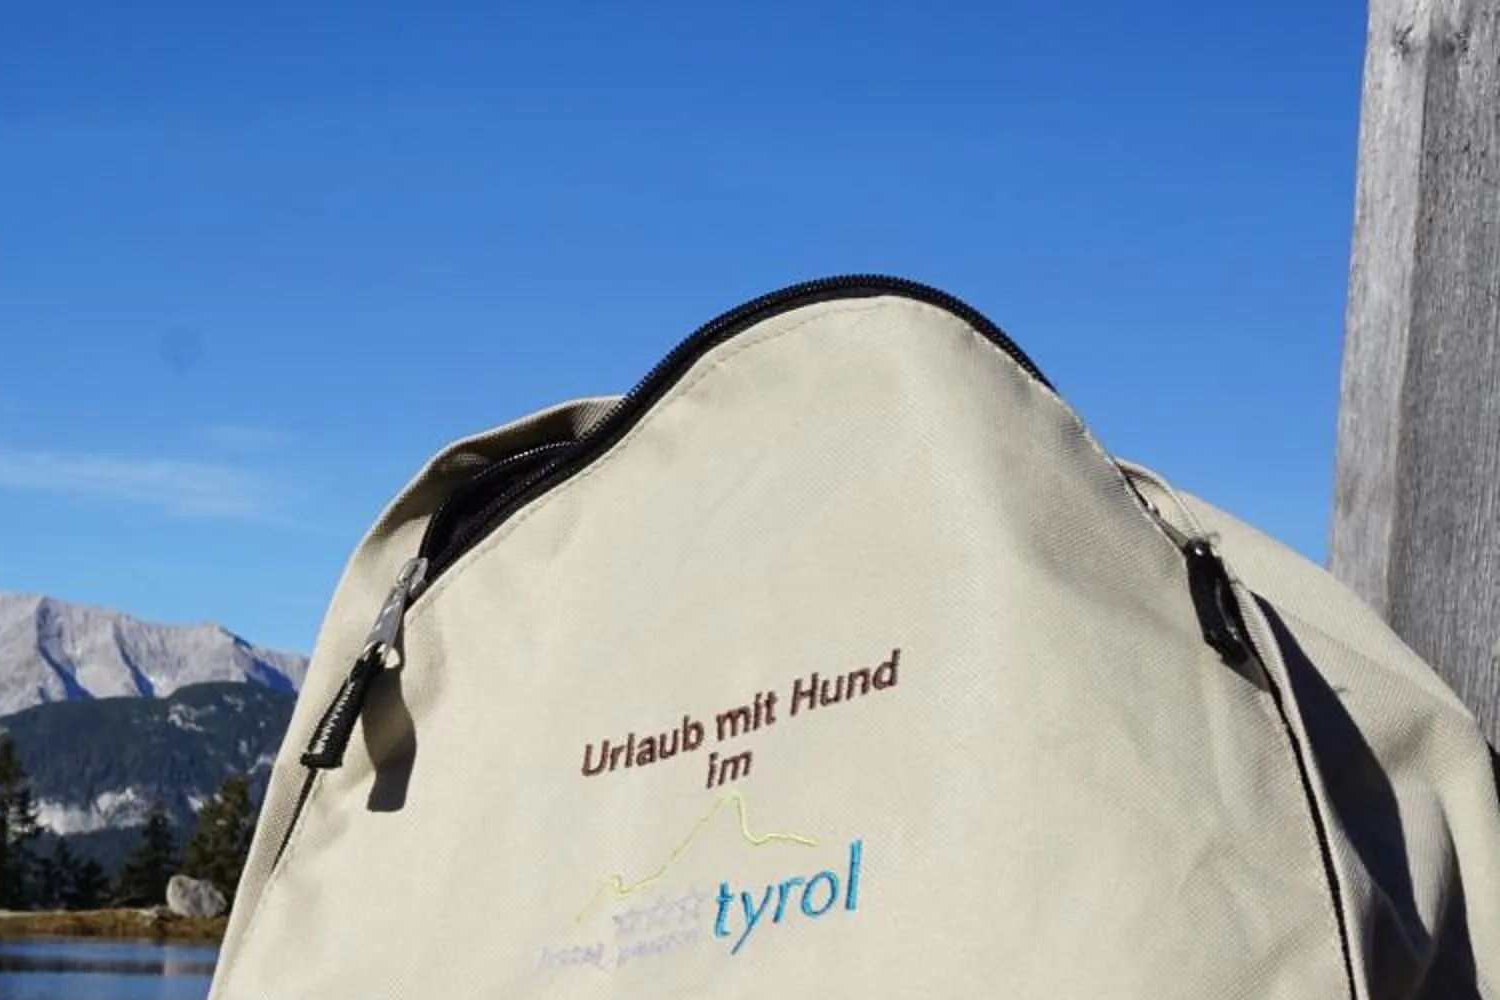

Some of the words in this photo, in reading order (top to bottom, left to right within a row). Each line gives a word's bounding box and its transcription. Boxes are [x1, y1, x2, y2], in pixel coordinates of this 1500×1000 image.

[581, 715, 705, 777] Urlaub
[715, 690, 778, 742] mit
[789, 648, 901, 717] Hund
[705, 751, 753, 790] im
[713, 839, 863, 955] tyrol
